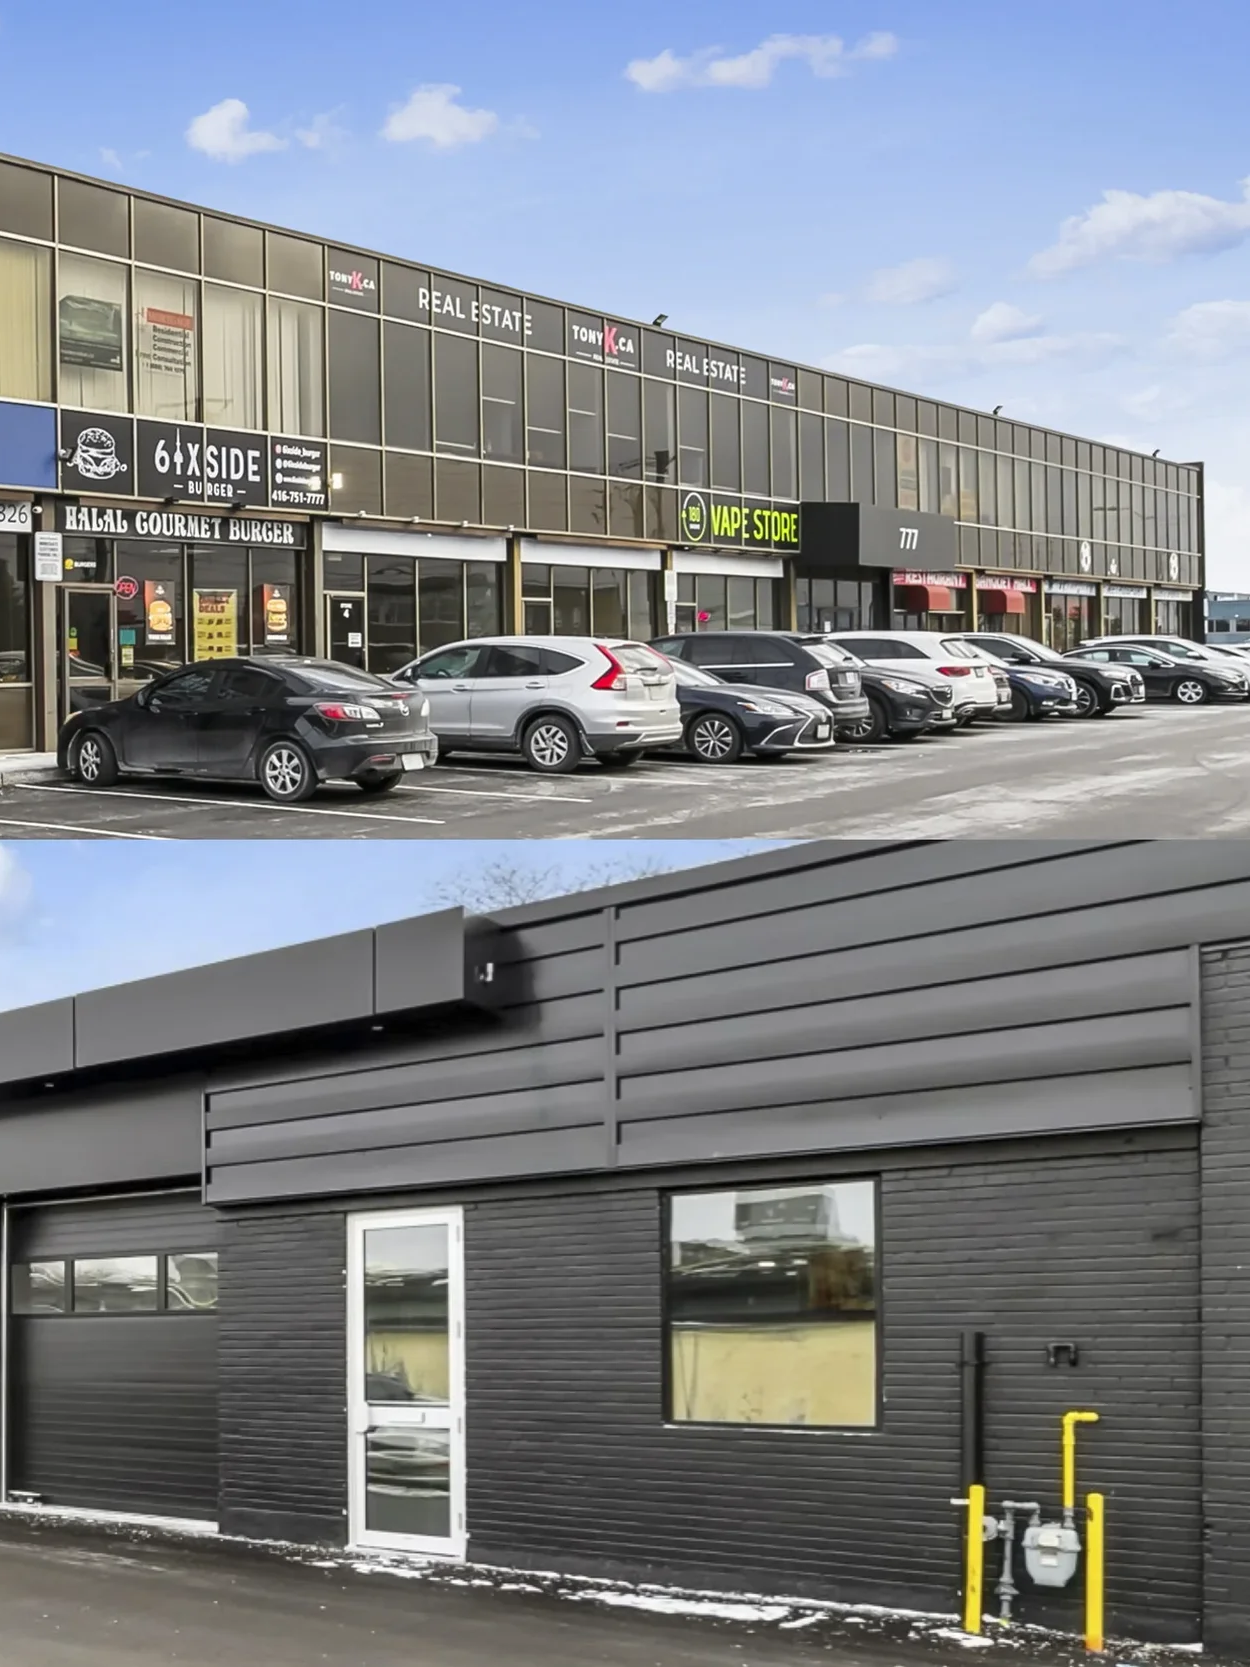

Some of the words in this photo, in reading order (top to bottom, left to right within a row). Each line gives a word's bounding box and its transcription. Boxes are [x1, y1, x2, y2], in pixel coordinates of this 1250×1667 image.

[418, 287, 466, 319] REAL
[471, 300, 533, 335] ESTATE
[572, 325, 634, 355] TONYK.CA
[666, 349, 700, 375] REAL
[703, 357, 746, 385] ESTATE
[188, 480, 234, 497] BURGER
[272, 490, 325, 505] 416-751-7777
[65, 505, 128, 534] HALAL
[135, 511, 222, 540] GOURMET
[229, 519, 294, 545] BURGER
[711, 504, 750, 539] VAPE
[753, 509, 799, 543] STORE
[899, 527, 919, 550] 777
